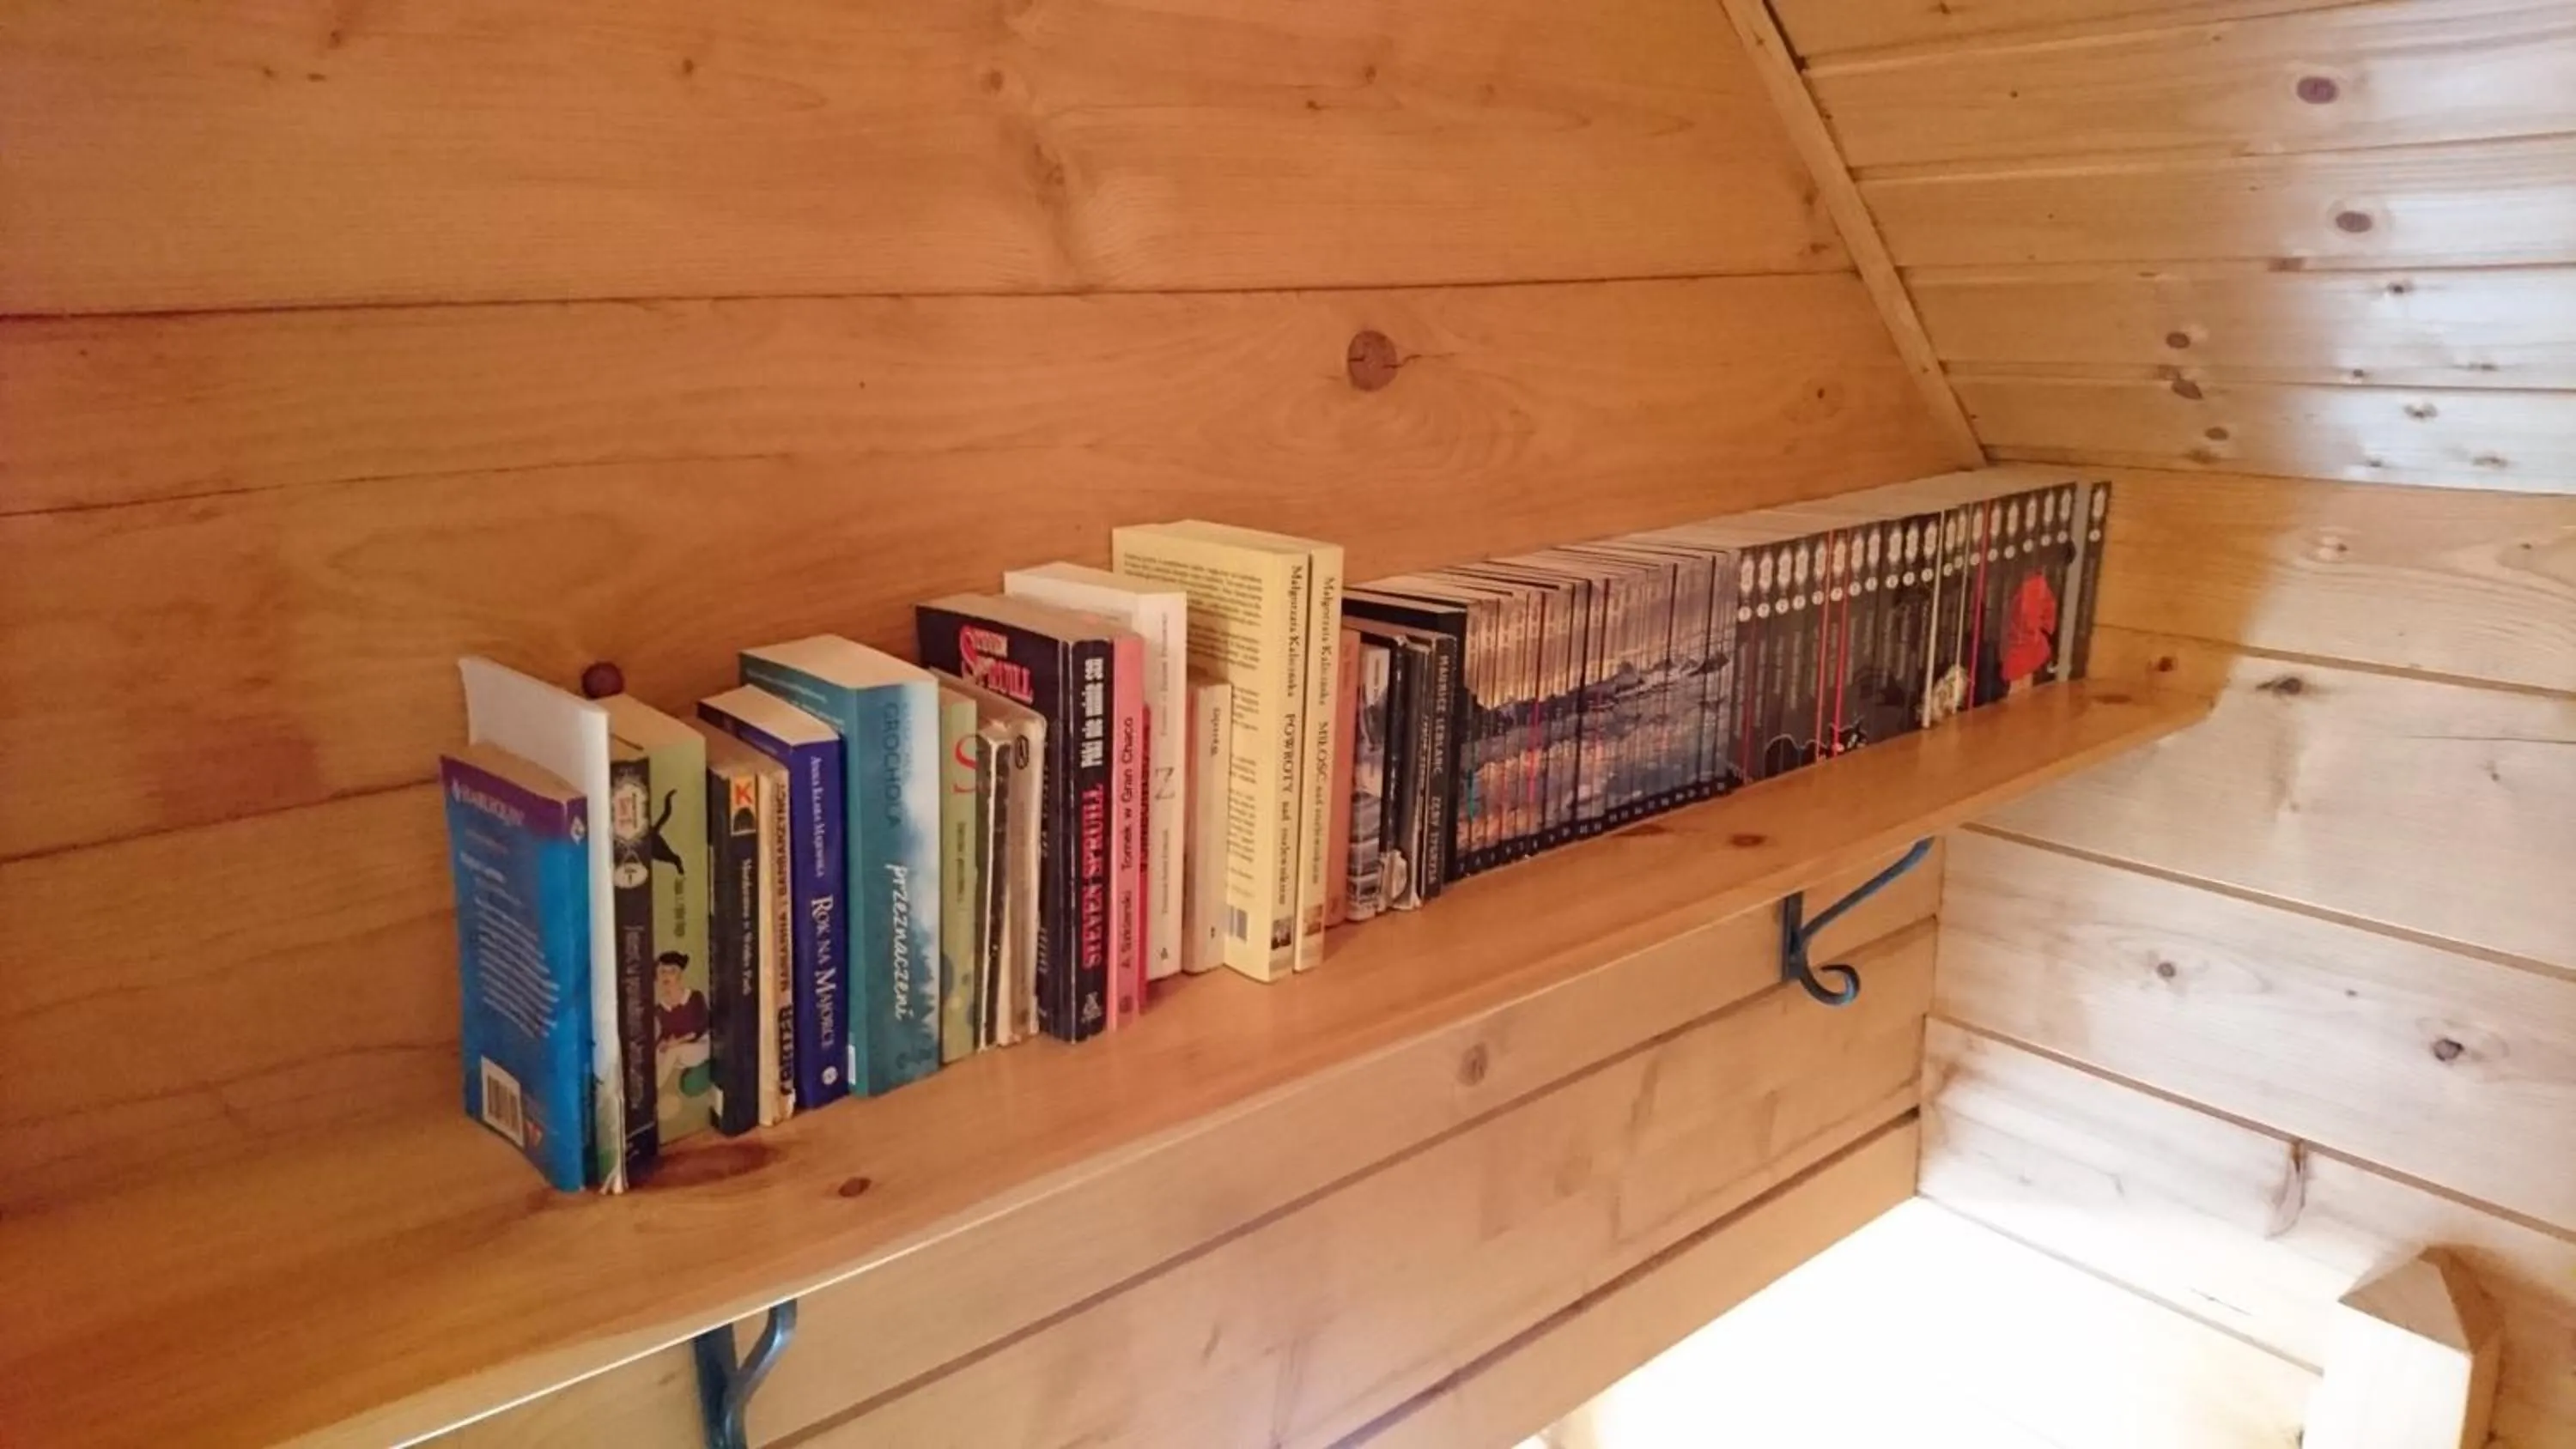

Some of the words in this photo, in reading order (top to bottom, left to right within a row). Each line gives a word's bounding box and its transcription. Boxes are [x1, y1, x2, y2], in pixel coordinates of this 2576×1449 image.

[1435, 655, 1449, 713] MAURICE
[1120, 716, 1133, 763] Chaco
[1282, 713, 1297, 793] POWROTY
[735, 781, 753, 805] K
[1121, 767, 1133, 803] Gran
[1082, 782, 1104, 878] SPRUILL
[1121, 824, 1133, 870] Tomek
[811, 895, 834, 934] ROK
[1082, 882, 1103, 969] STEVEN
[815, 940, 833, 964] NA
[884, 864, 915, 1020] przeznaczeni
